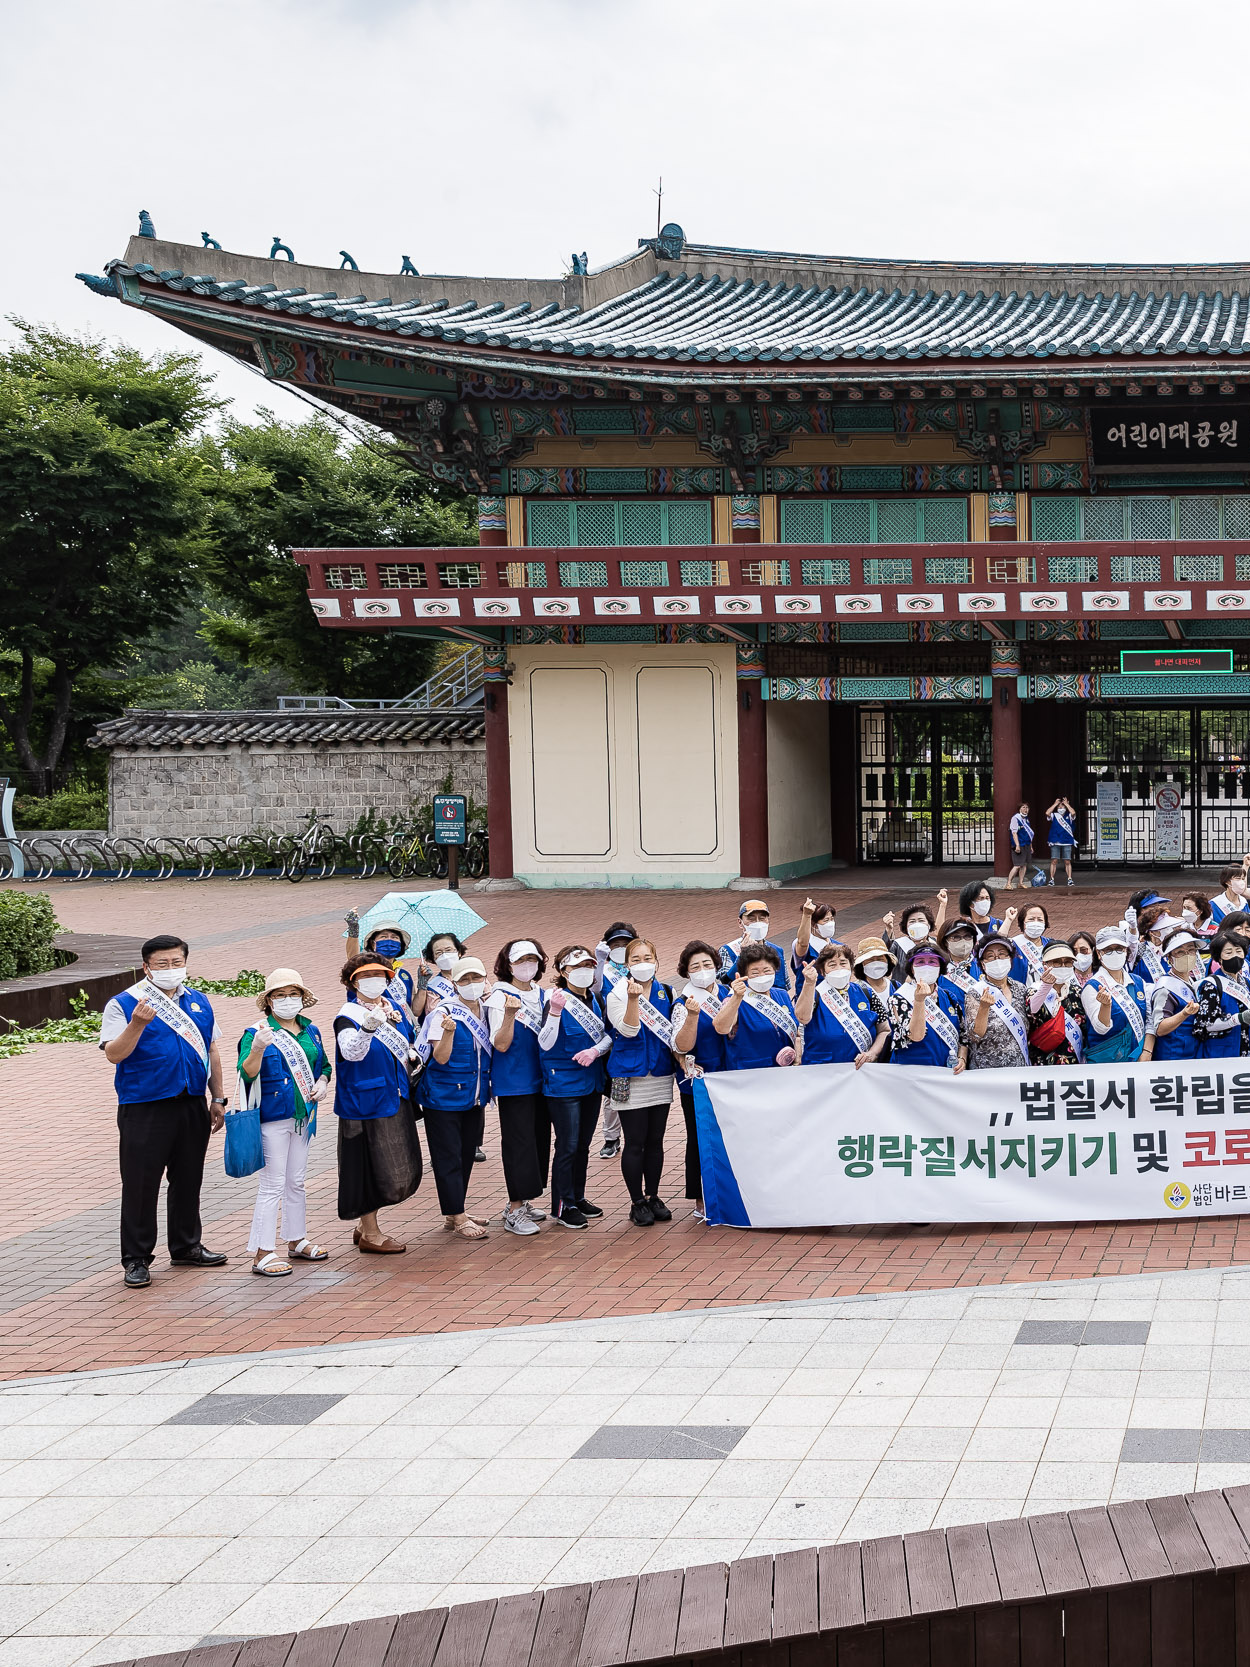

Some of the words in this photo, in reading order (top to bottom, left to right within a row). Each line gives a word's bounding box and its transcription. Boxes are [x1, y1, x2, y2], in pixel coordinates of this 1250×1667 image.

[1107, 419, 1239, 449] 어린이대공원
[1175, 657, 1201, 666] 대피먼저
[837, 1131, 1118, 1179] 행락질서지키기
[1132, 1129, 1170, 1174] 및
[1192, 1183, 1212, 1195] 사단
[1193, 1195, 1212, 1207] 법인
